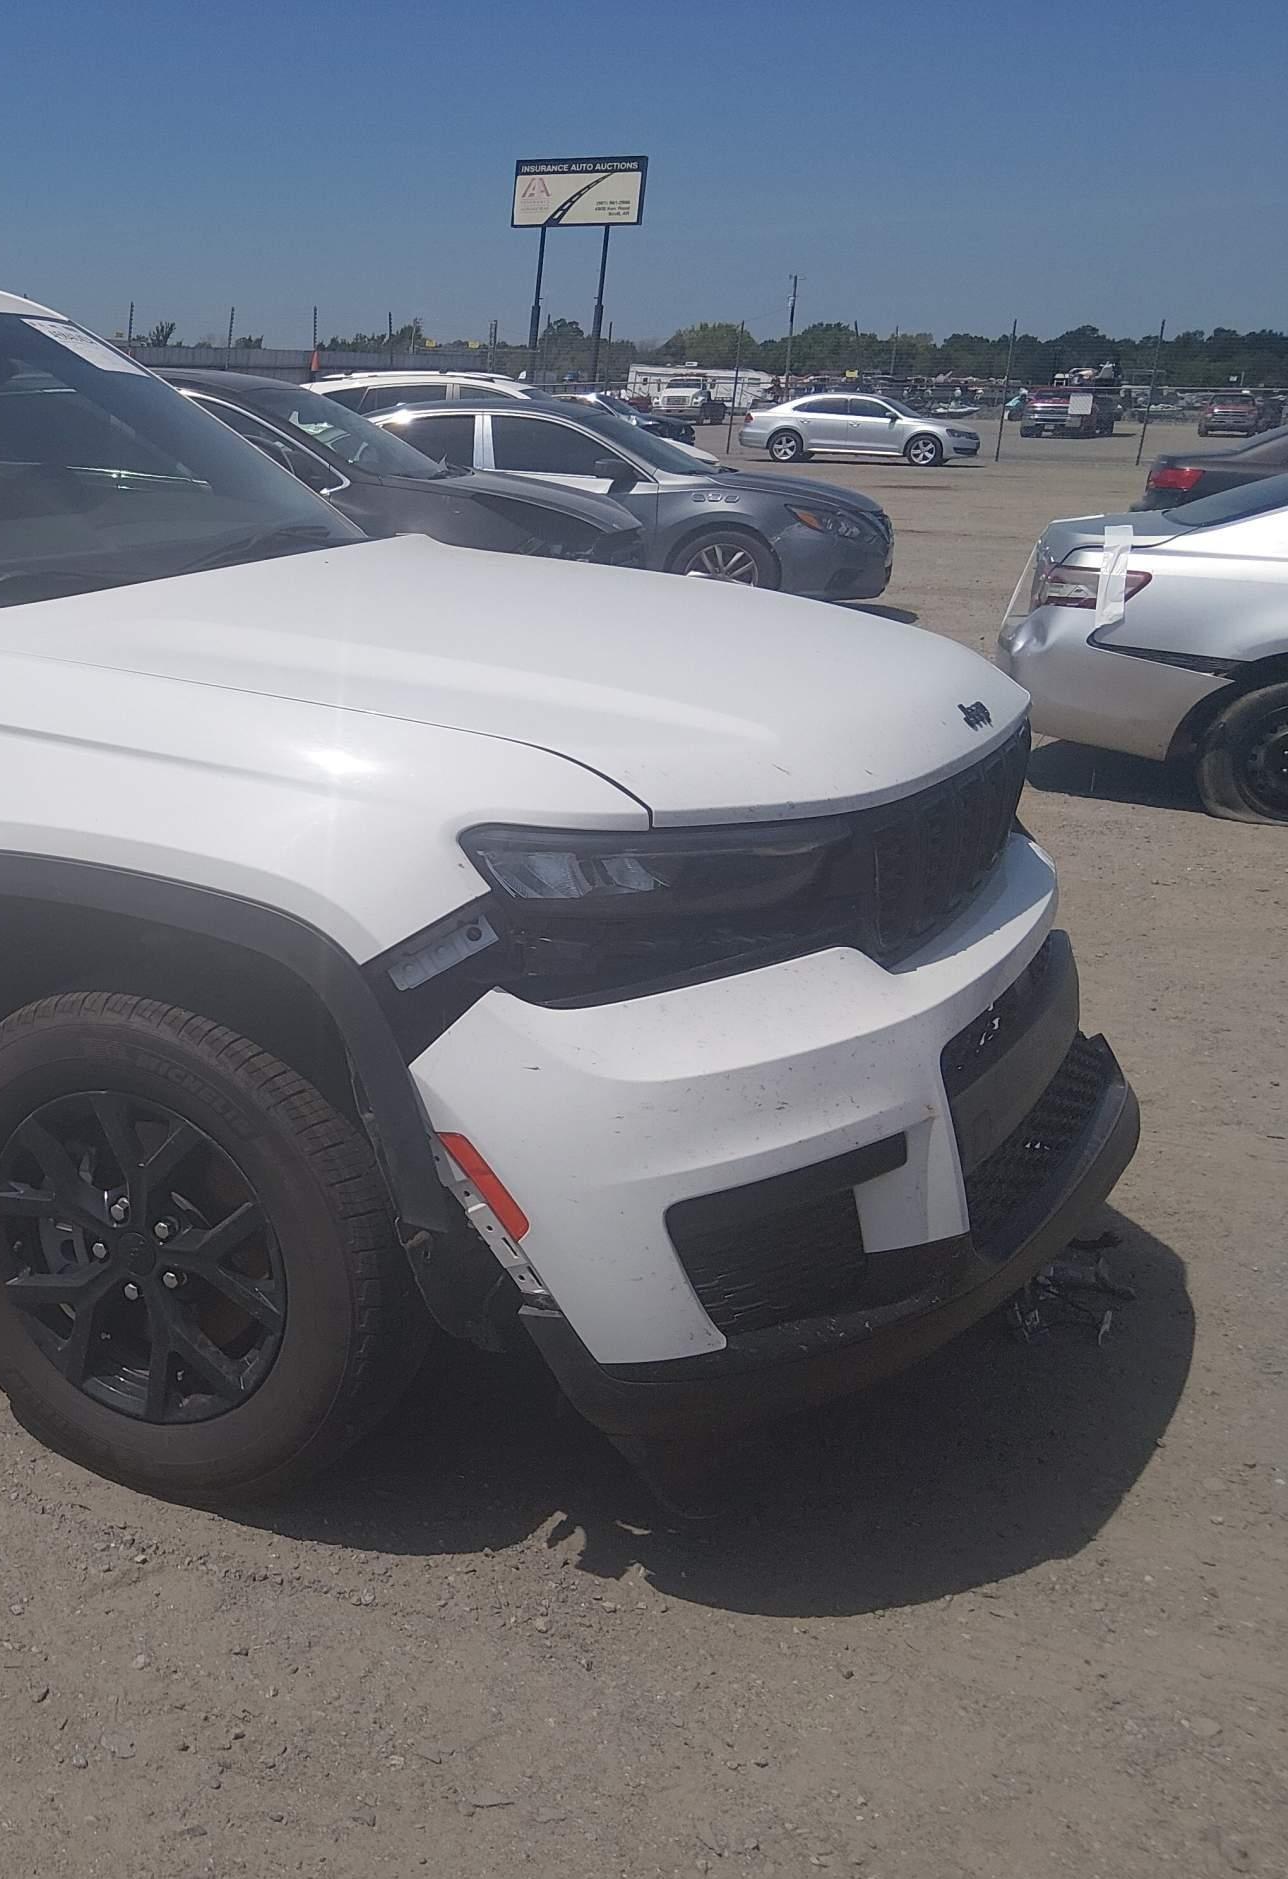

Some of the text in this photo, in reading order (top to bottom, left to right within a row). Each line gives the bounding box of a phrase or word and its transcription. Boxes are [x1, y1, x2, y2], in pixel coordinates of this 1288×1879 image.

[521, 161, 639, 174] INSURANCE AUTO AUCTIONS
